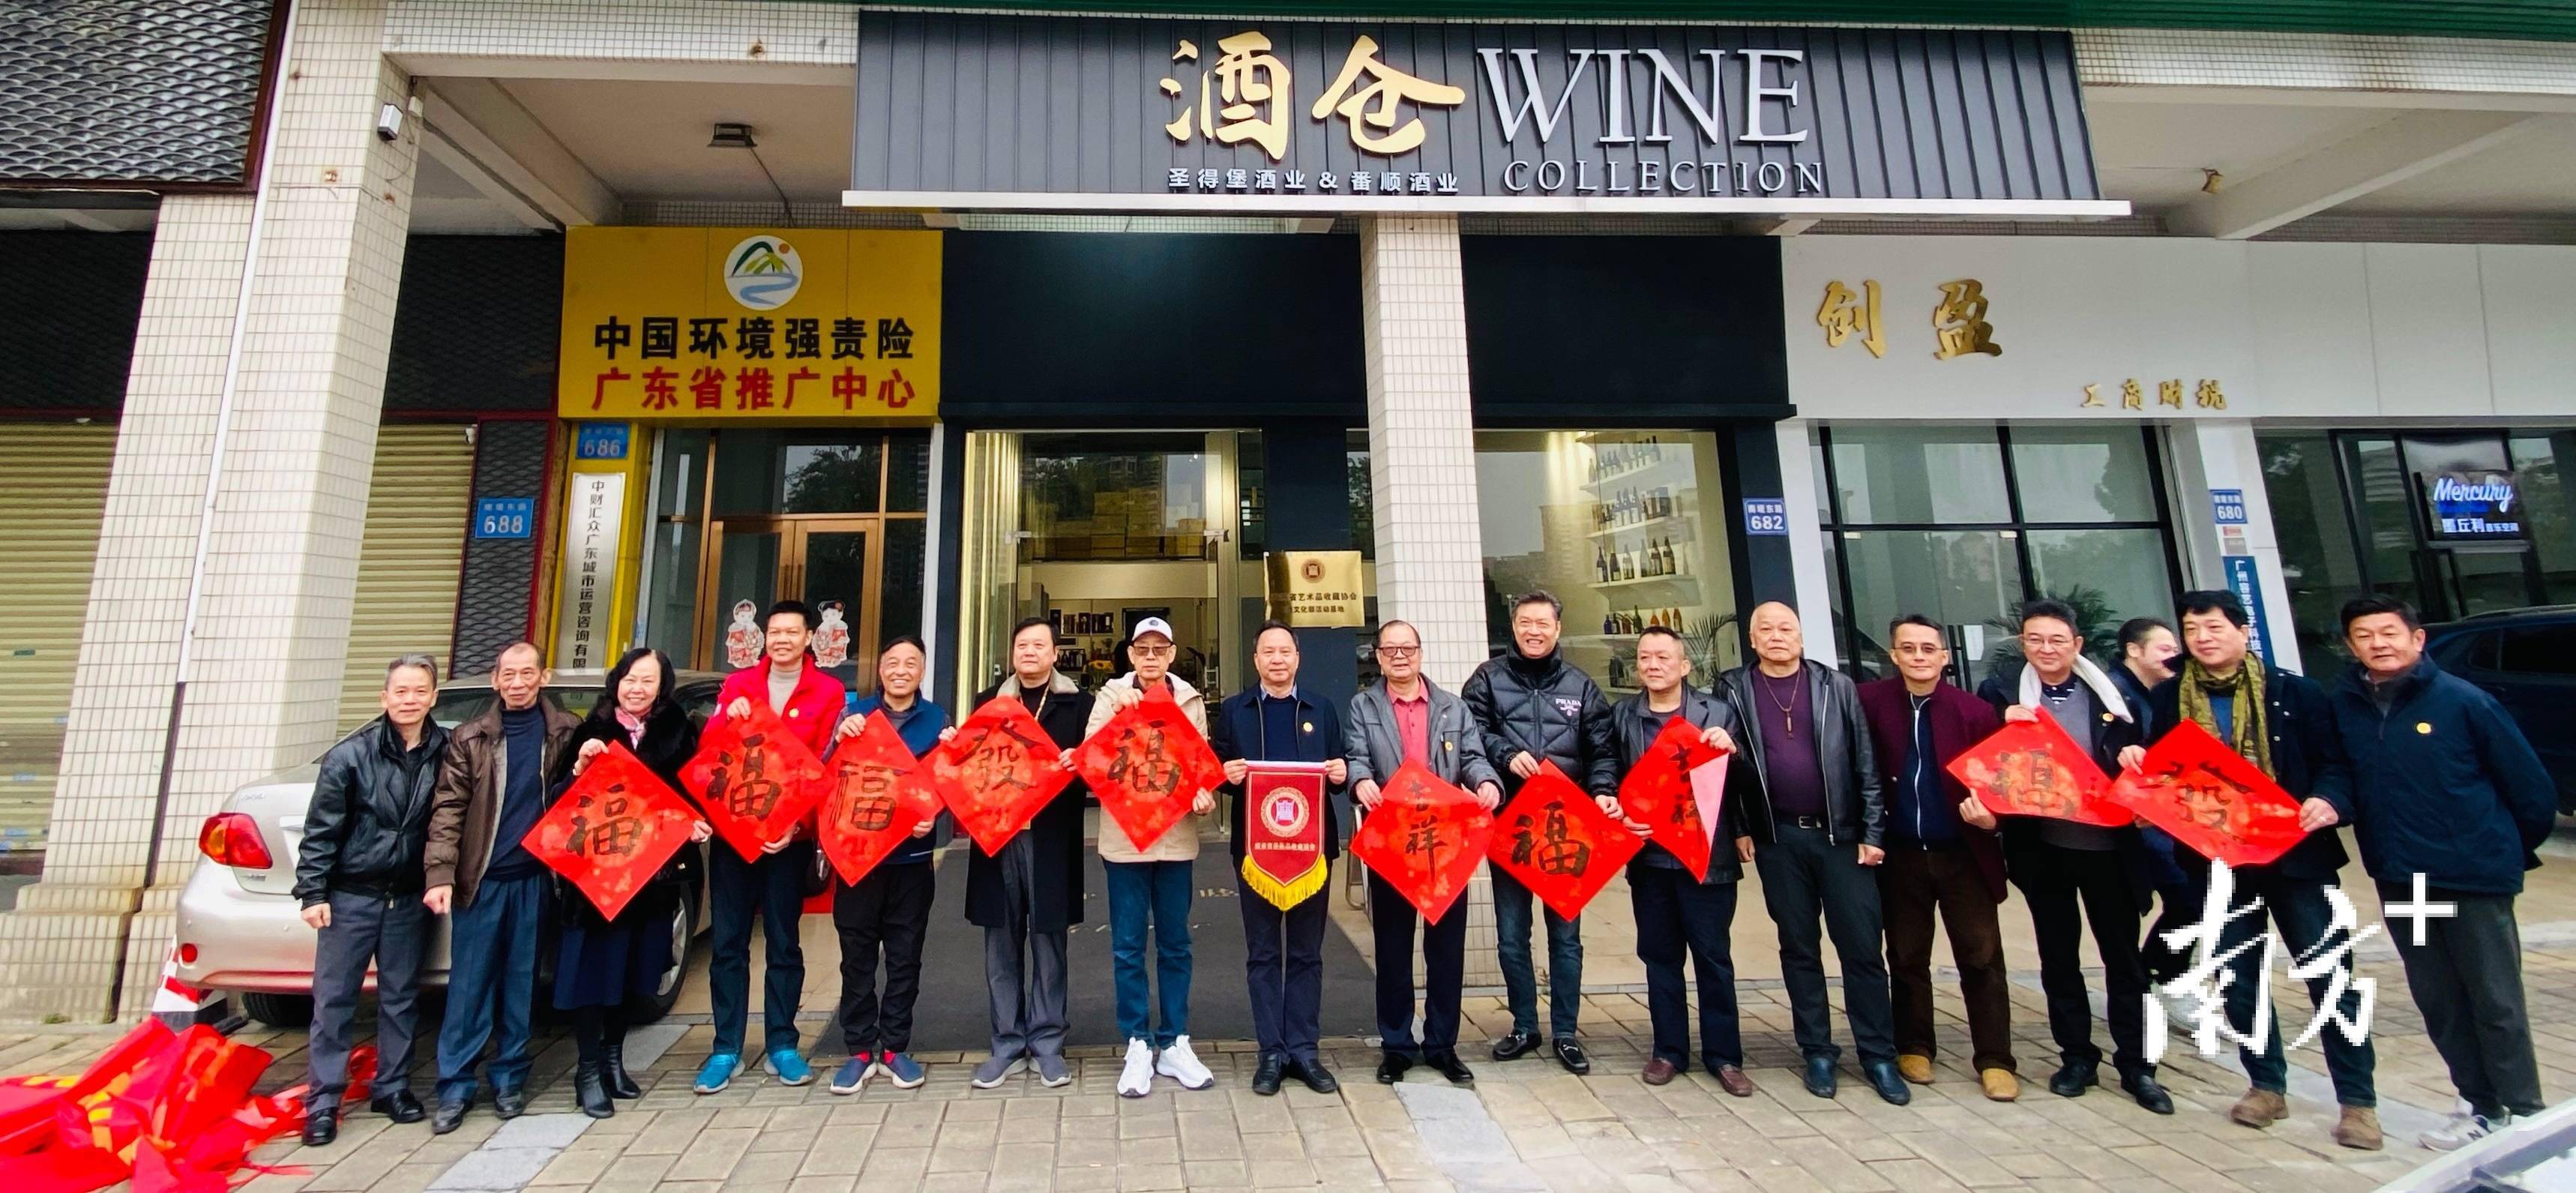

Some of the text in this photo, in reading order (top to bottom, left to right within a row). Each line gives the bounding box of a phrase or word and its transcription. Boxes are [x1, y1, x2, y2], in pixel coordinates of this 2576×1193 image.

[1161, 31, 1809, 160] 酒仓 WINE
[1168, 167, 1459, 193] 圣得堡酒业 & 番顺酒业
[1504, 160, 1823, 193] COLLECTION
[595, 315, 915, 361] 中国环境强责险
[1817, 278, 2002, 361] 创盈
[592, 366, 916, 412] 广东省推广中心
[2080, 378, 2228, 412] 工商财税
[584, 439, 622, 456] 686
[2217, 505, 2243, 520] 680
[2434, 478, 2513, 513] Mercury
[484, 515, 523, 534] 688
[1751, 515, 1784, 530] 682
[1271, 592, 1358, 601] 省艺术品收藏协会
[1556, 698, 1582, 707] PRADA
[706, 734, 783, 822] 福
[1107, 719, 1182, 798] 福
[828, 759, 913, 832] 福
[565, 782, 643, 856] 福
[1405, 778, 1448, 882] 吉祥
[1511, 800, 1591, 879] 福
